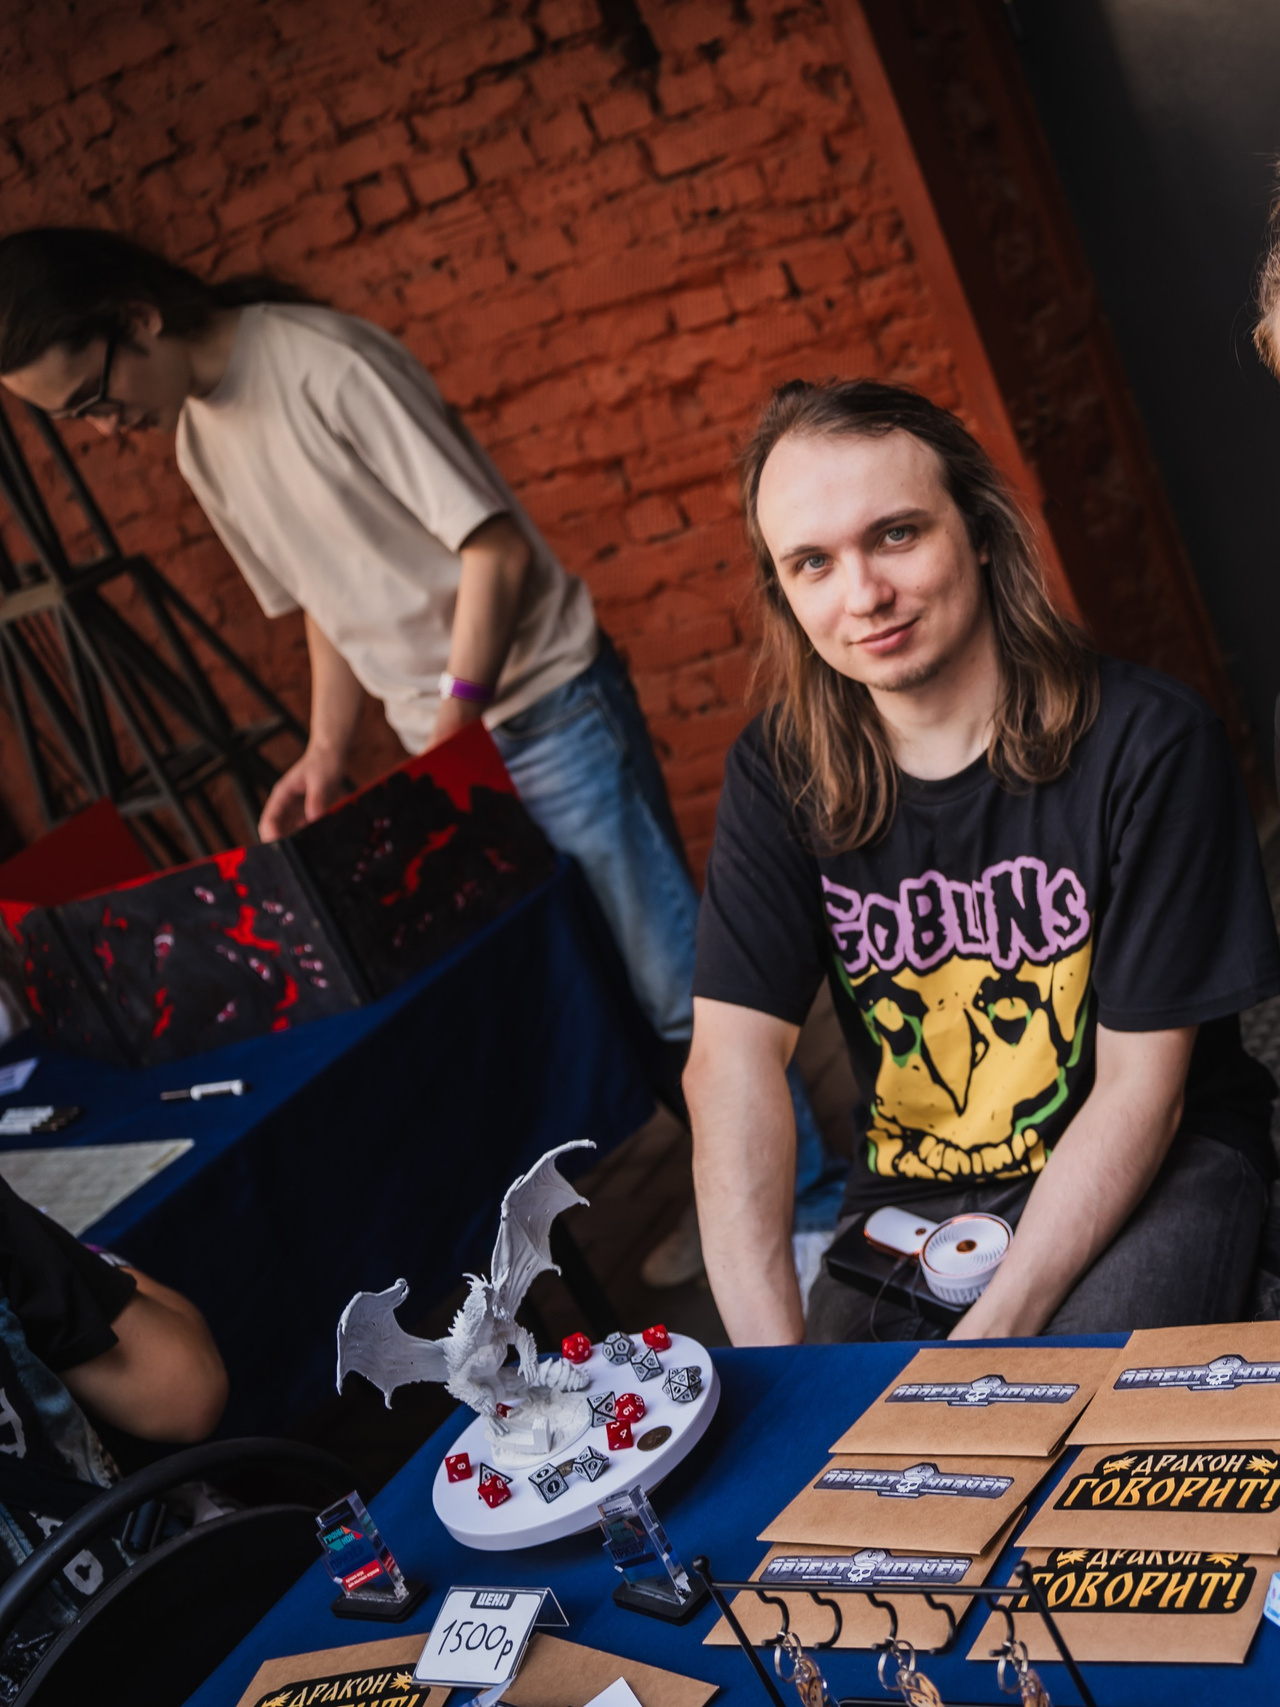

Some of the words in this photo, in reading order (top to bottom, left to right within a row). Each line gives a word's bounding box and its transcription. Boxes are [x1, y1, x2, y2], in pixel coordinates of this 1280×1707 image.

[1131, 1454, 1246, 1476] ДРАКОН
[1086, 1549, 1202, 1570] ДРАКОН
[476, 1592, 510, 1607] ЦЕНА
[1018, 1570, 1246, 1609] ГОВОРИТ!
[288, 1673, 392, 1707] ДРАКОН
